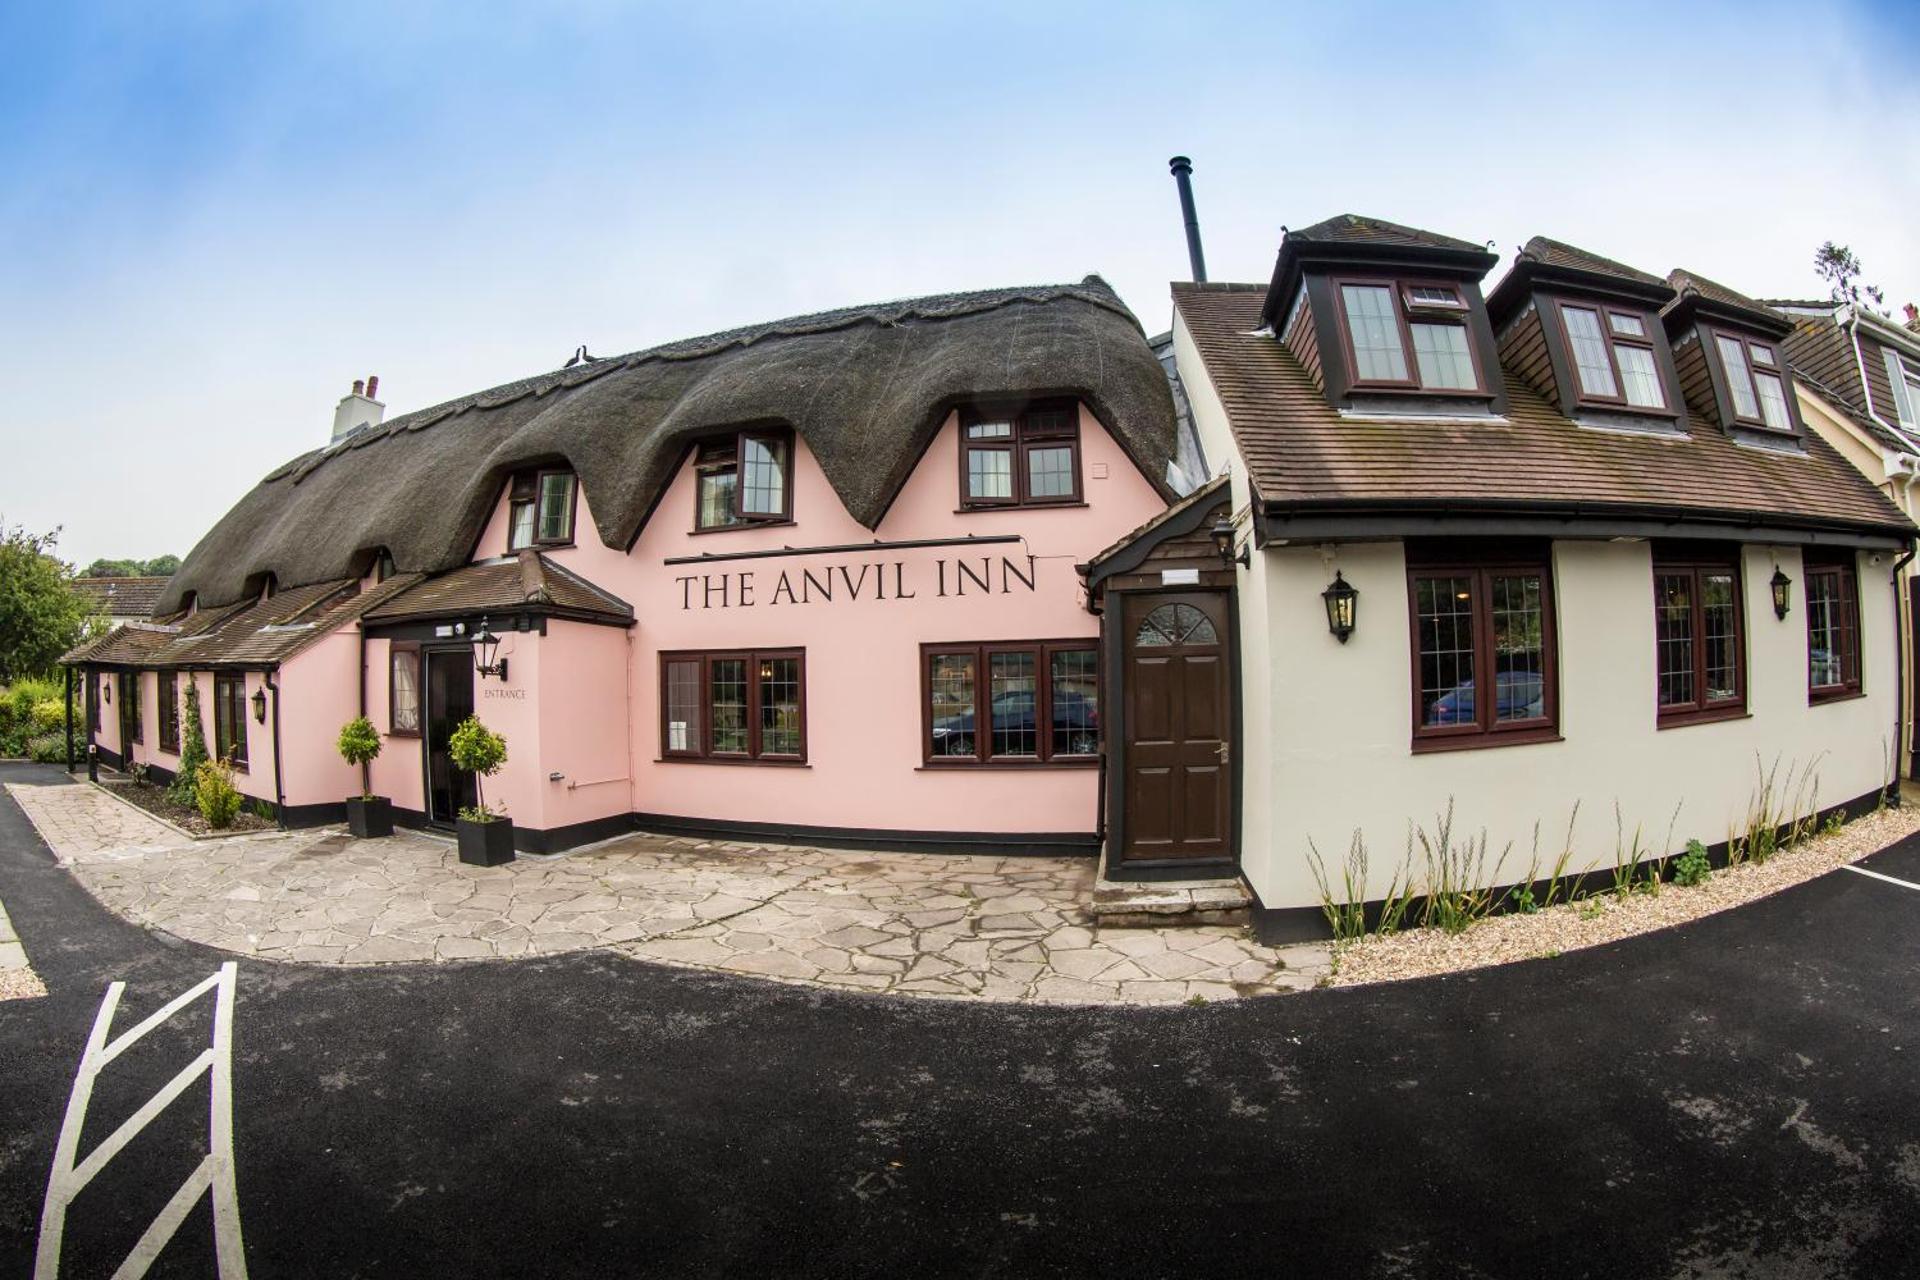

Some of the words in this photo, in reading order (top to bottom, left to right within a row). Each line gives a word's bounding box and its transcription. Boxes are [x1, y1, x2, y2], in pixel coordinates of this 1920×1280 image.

[676, 572, 755, 610] THE
[769, 562, 916, 606] ANVIL
[936, 555, 1036, 598] INN
[484, 689, 527, 699] ENTRANCE
